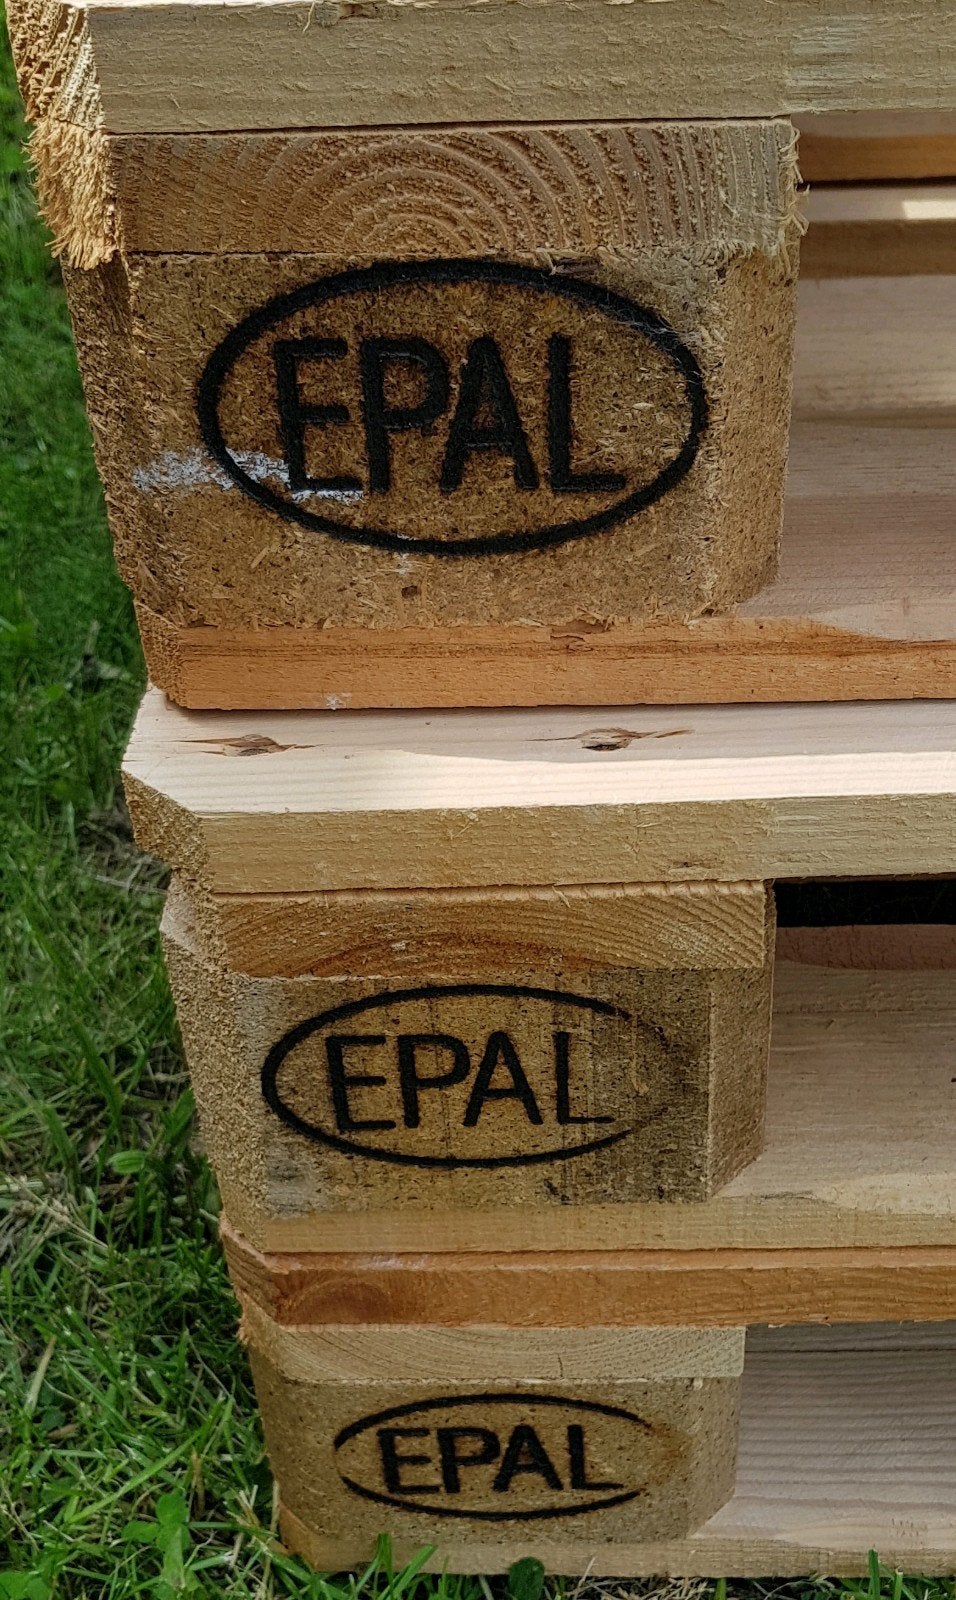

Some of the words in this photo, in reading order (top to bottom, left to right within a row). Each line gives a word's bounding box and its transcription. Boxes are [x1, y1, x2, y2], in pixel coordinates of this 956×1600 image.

[274, 333, 627, 494] EPAL
[325, 1031, 615, 1132] EPAL
[376, 1424, 624, 1494] EPAL
